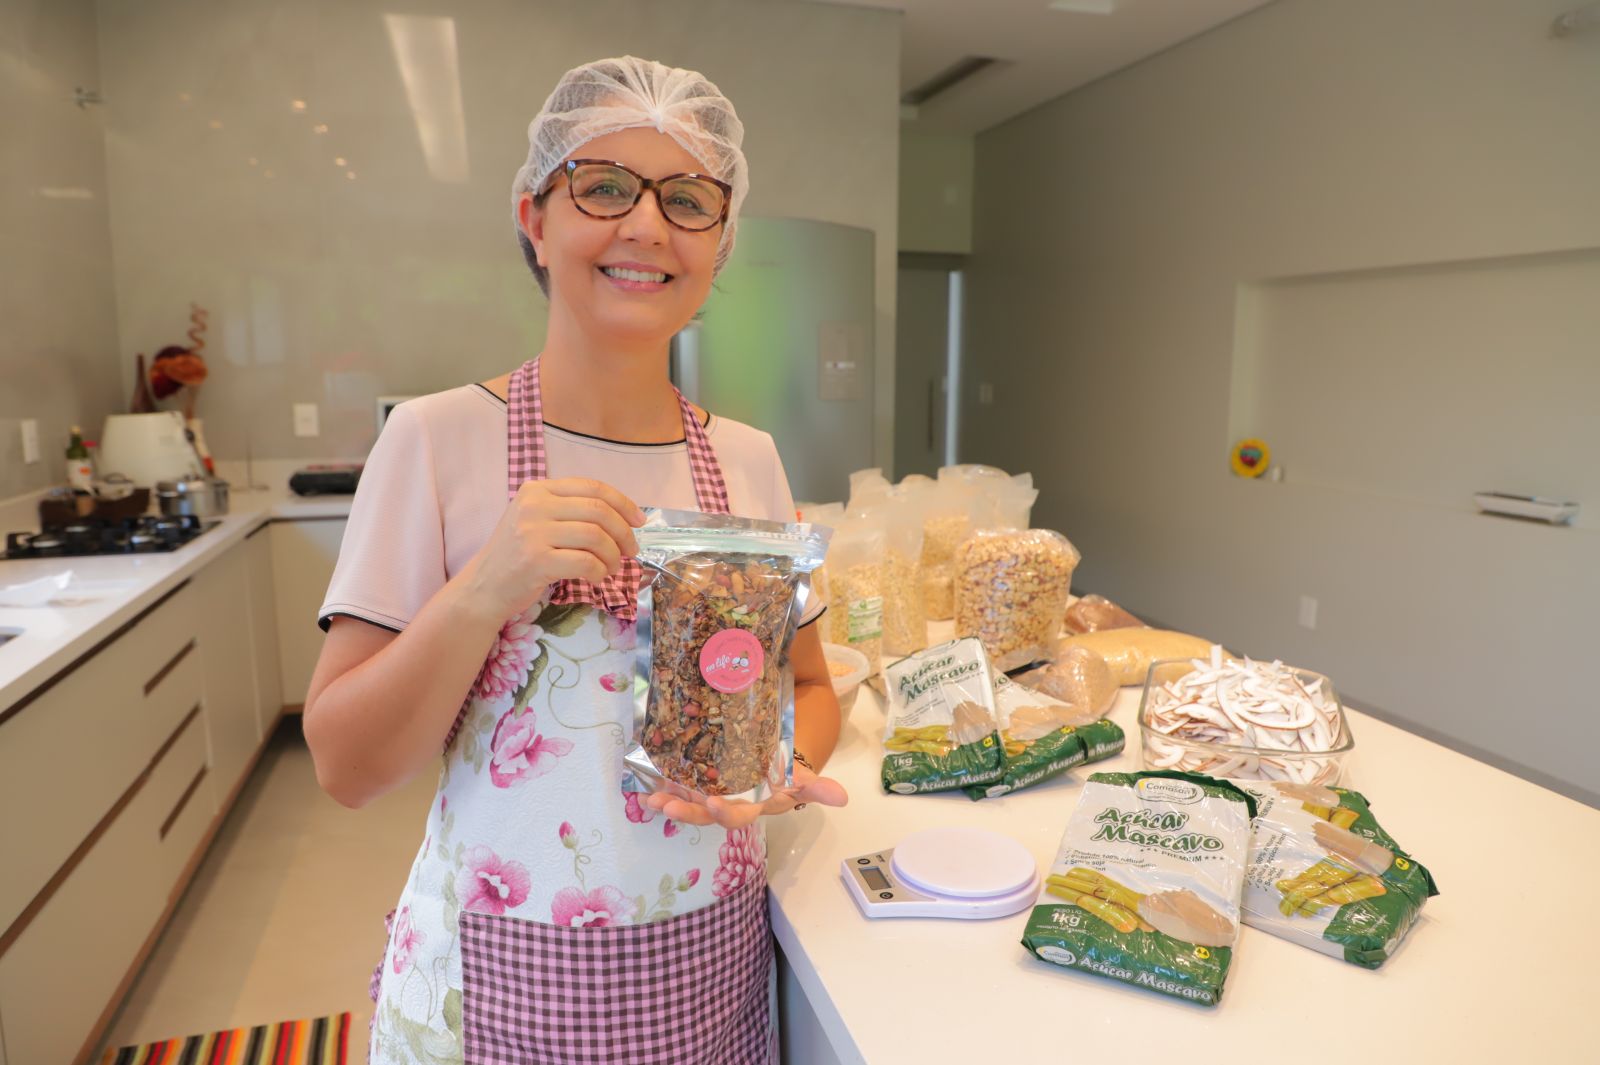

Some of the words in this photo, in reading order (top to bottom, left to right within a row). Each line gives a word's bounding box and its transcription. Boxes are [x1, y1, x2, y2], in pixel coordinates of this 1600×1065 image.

[893, 755, 913, 768] 1kg
[1094, 807, 1190, 832] Açúcar
[1090, 823, 1225, 852] Mascavo
[1051, 912, 1081, 927] 1kg
[1079, 957, 1134, 980] Açúcar
[1136, 970, 1212, 1001] Mascavo
